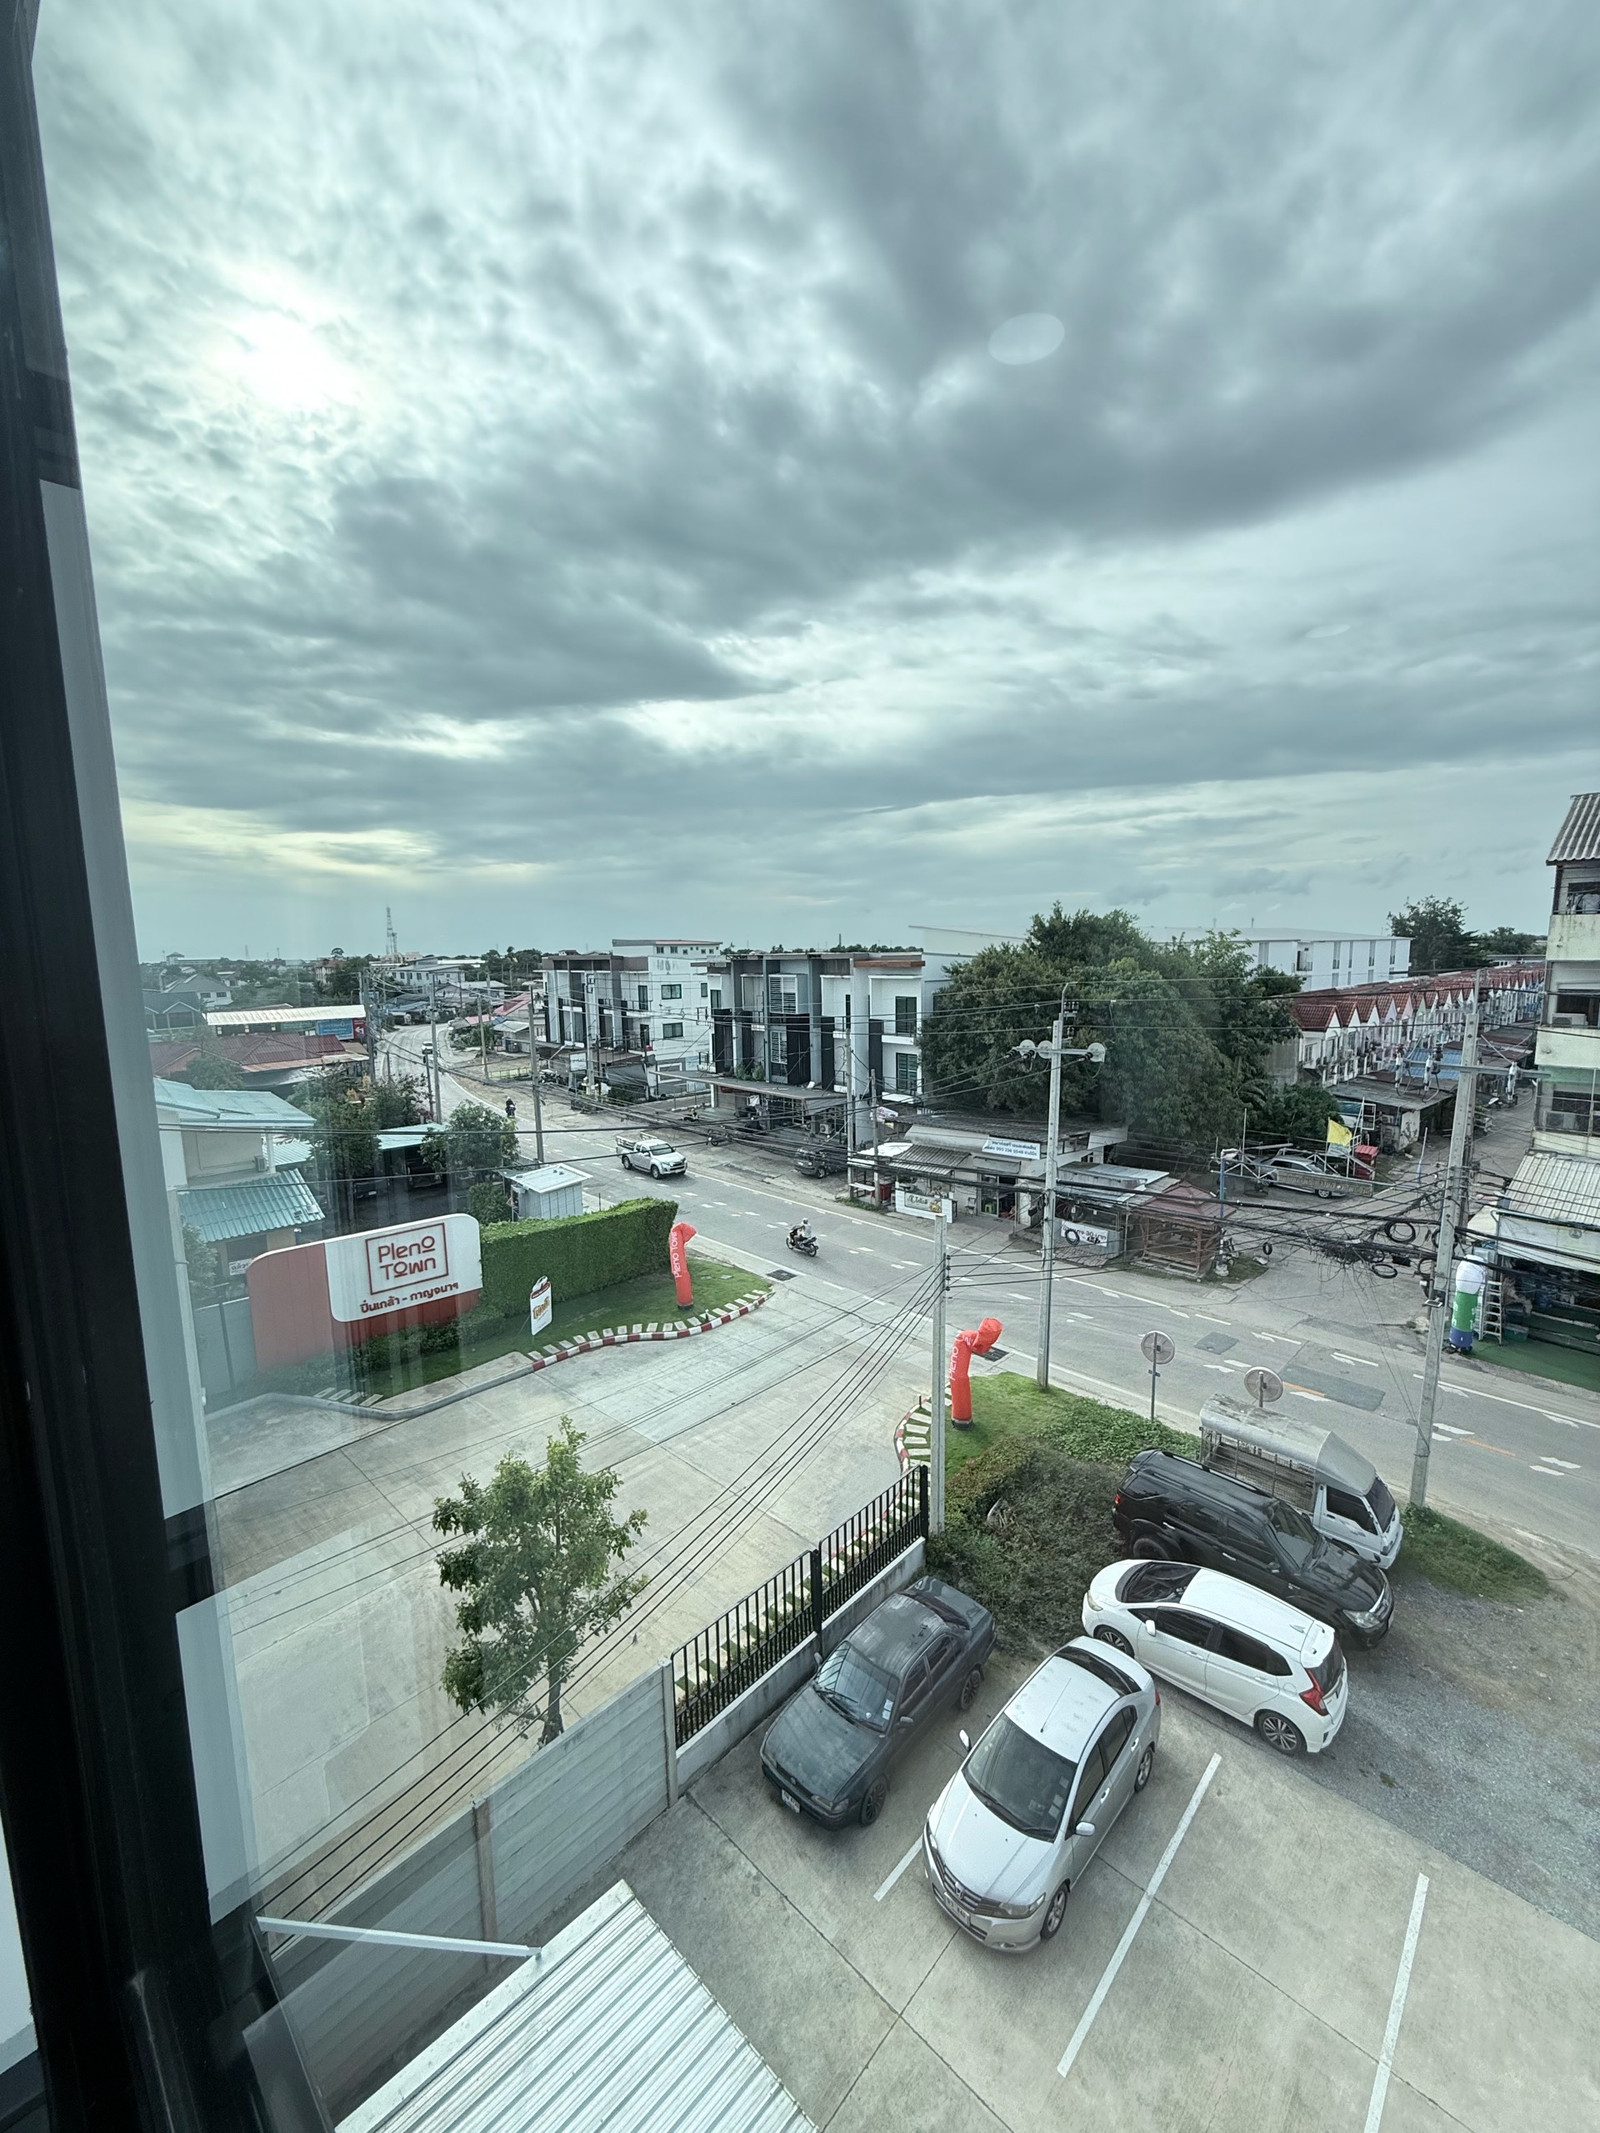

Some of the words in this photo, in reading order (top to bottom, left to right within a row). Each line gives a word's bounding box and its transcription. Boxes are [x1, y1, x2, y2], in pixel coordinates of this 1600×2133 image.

[378, 1236, 435, 1263] Pleno
[671, 1252, 683, 1279] Pleno
[360, 1295, 400, 1313] ปิ่นเกล้า
[410, 1282, 459, 1301] กาญจนาฯ
[948, 1346, 959, 1381] Pleno
